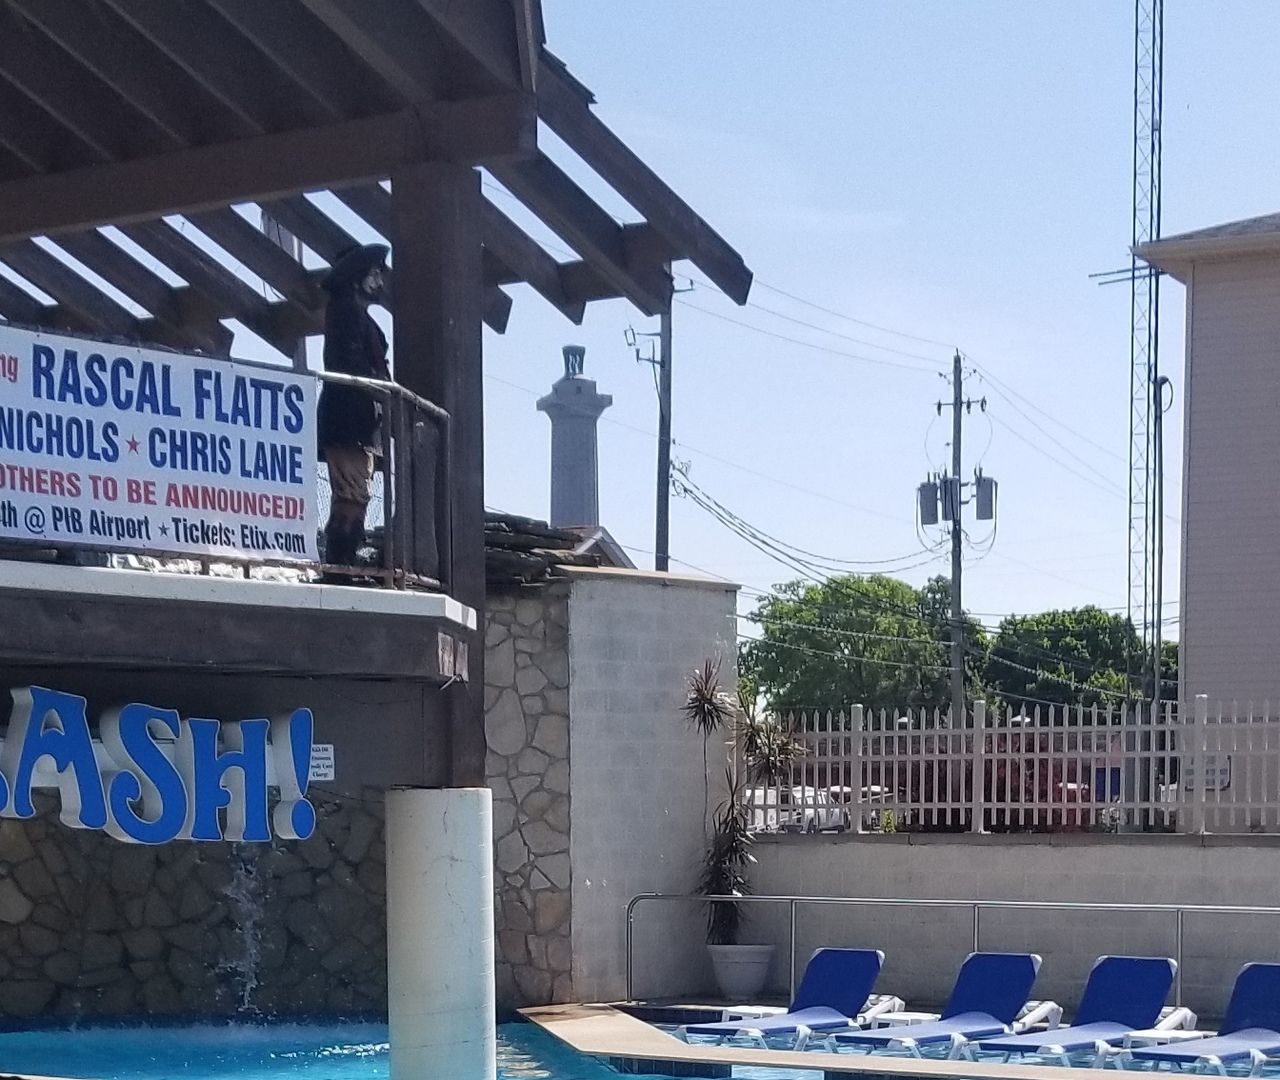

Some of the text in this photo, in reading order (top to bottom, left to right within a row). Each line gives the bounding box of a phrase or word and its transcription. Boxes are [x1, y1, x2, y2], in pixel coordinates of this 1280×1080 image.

[32, 343, 182, 418] RASCAL
[193, 368, 305, 434] FLATTS
[148, 426, 233, 475] CHRIS
[239, 437, 304, 485] LANE
[88, 474, 119, 502] TO
[126, 478, 158, 506] BE
[165, 481, 306, 521] ANNOUNCED!
[24, 505, 47, 535] @
[51, 505, 84, 534] PIB
[89, 508, 152, 542] Airport
[170, 515, 237, 548] Tickets:
[239, 523, 307, 555] Etix.com
